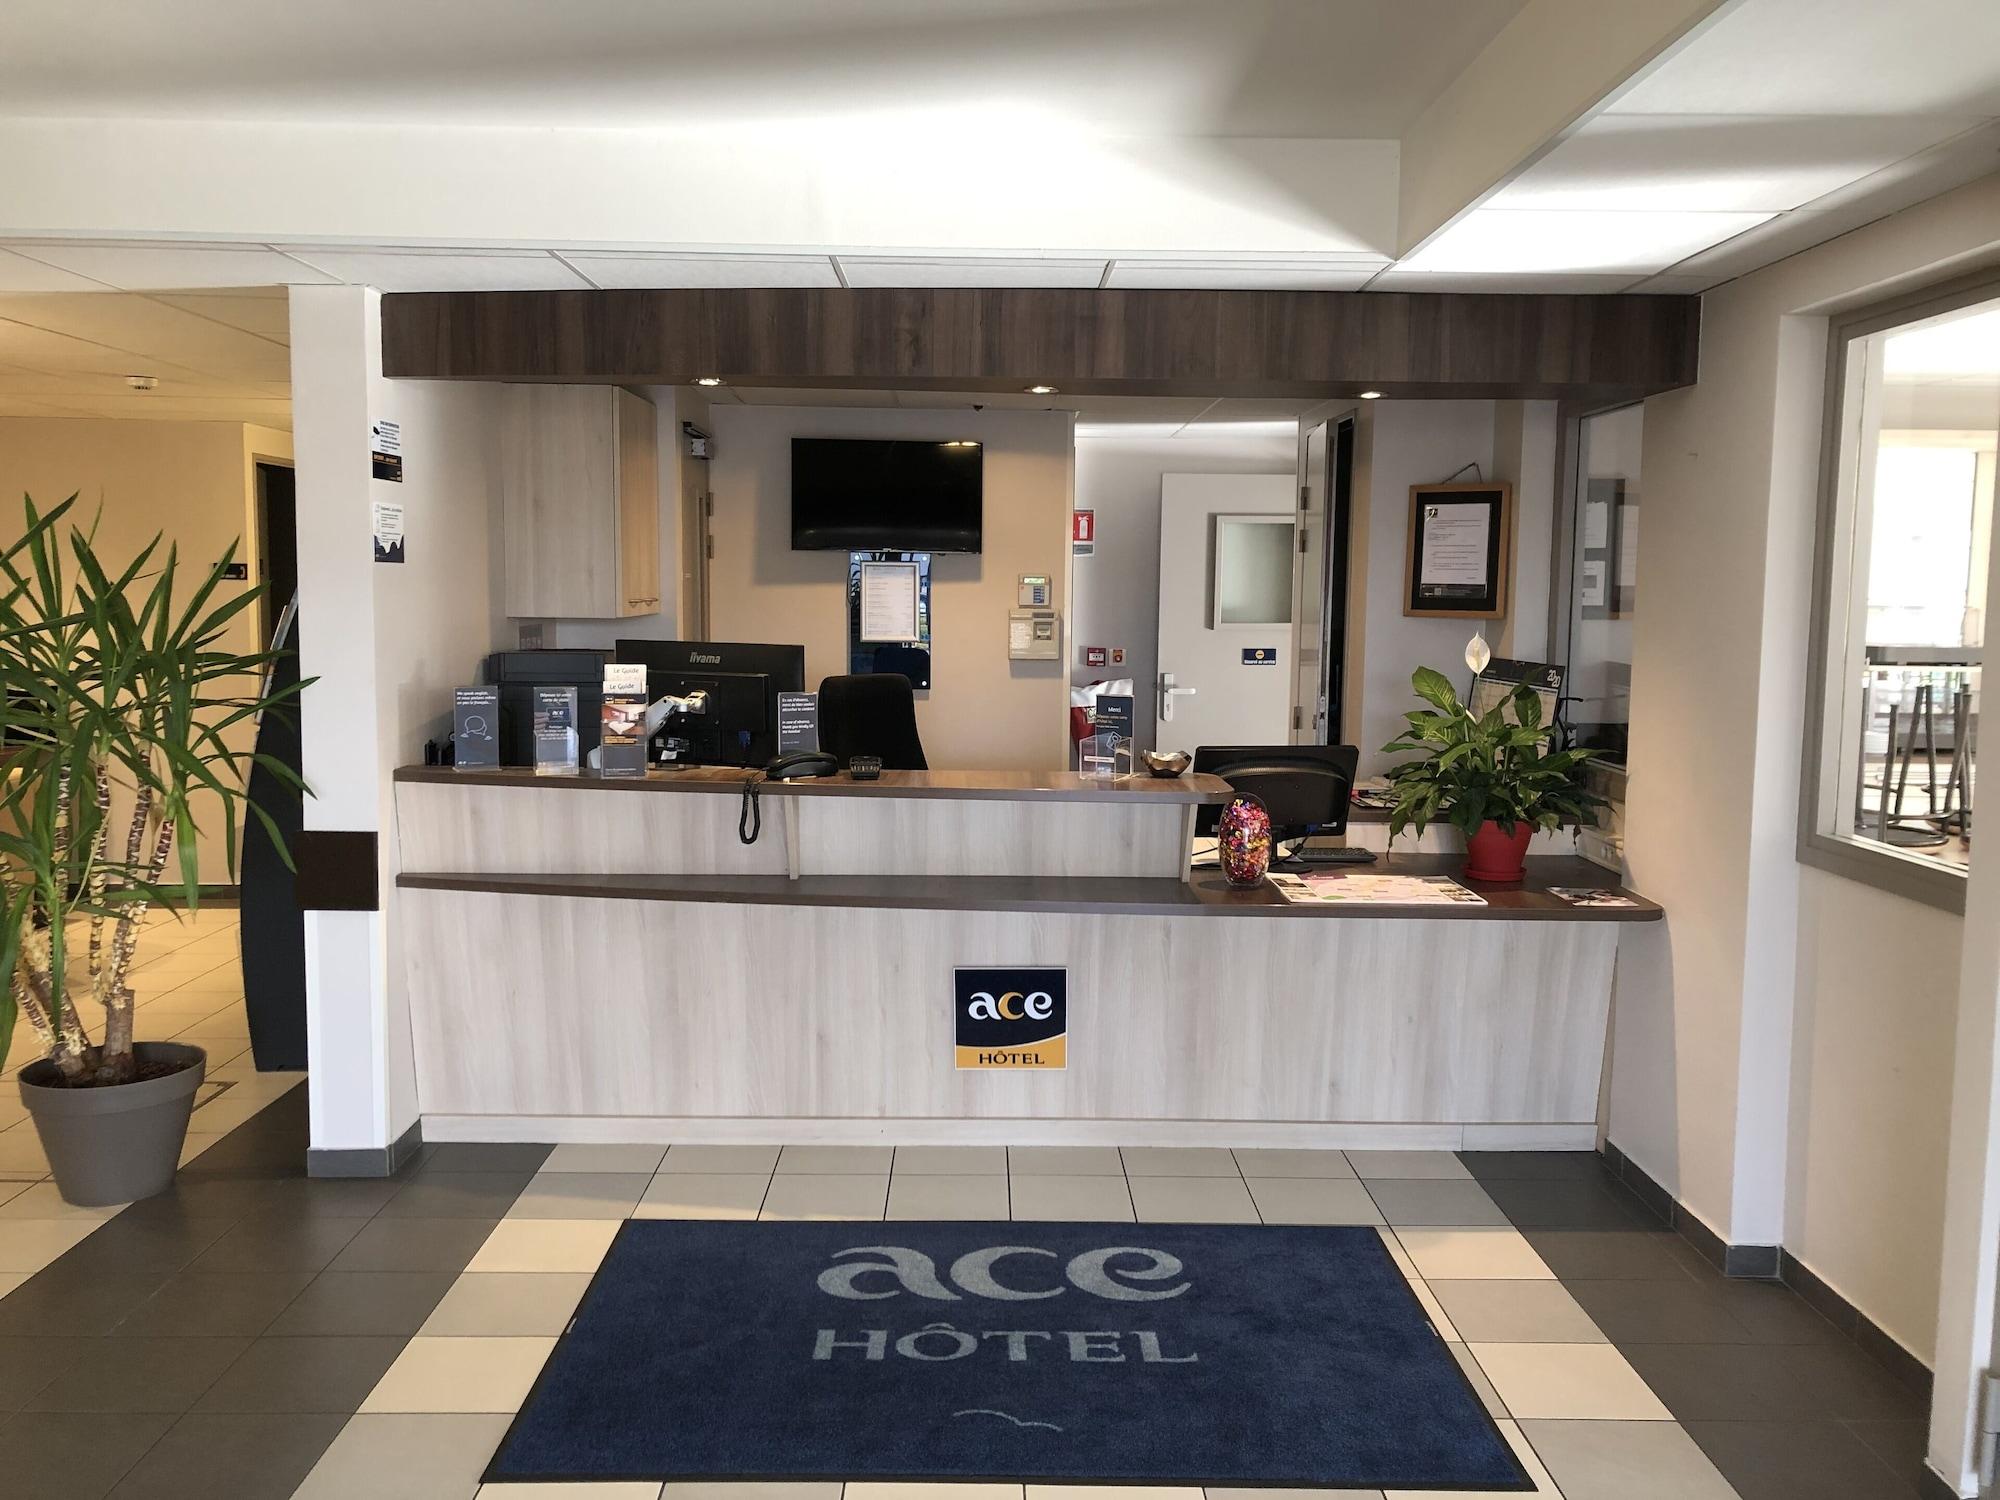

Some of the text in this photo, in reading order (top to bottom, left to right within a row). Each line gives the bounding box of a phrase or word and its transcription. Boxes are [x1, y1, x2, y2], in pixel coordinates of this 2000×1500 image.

[968, 991, 1053, 1020] ace
[979, 1050, 1045, 1065] HÔTEL
[816, 1246, 1192, 1301] ace
[812, 1322, 1199, 1363] HÔTEL
